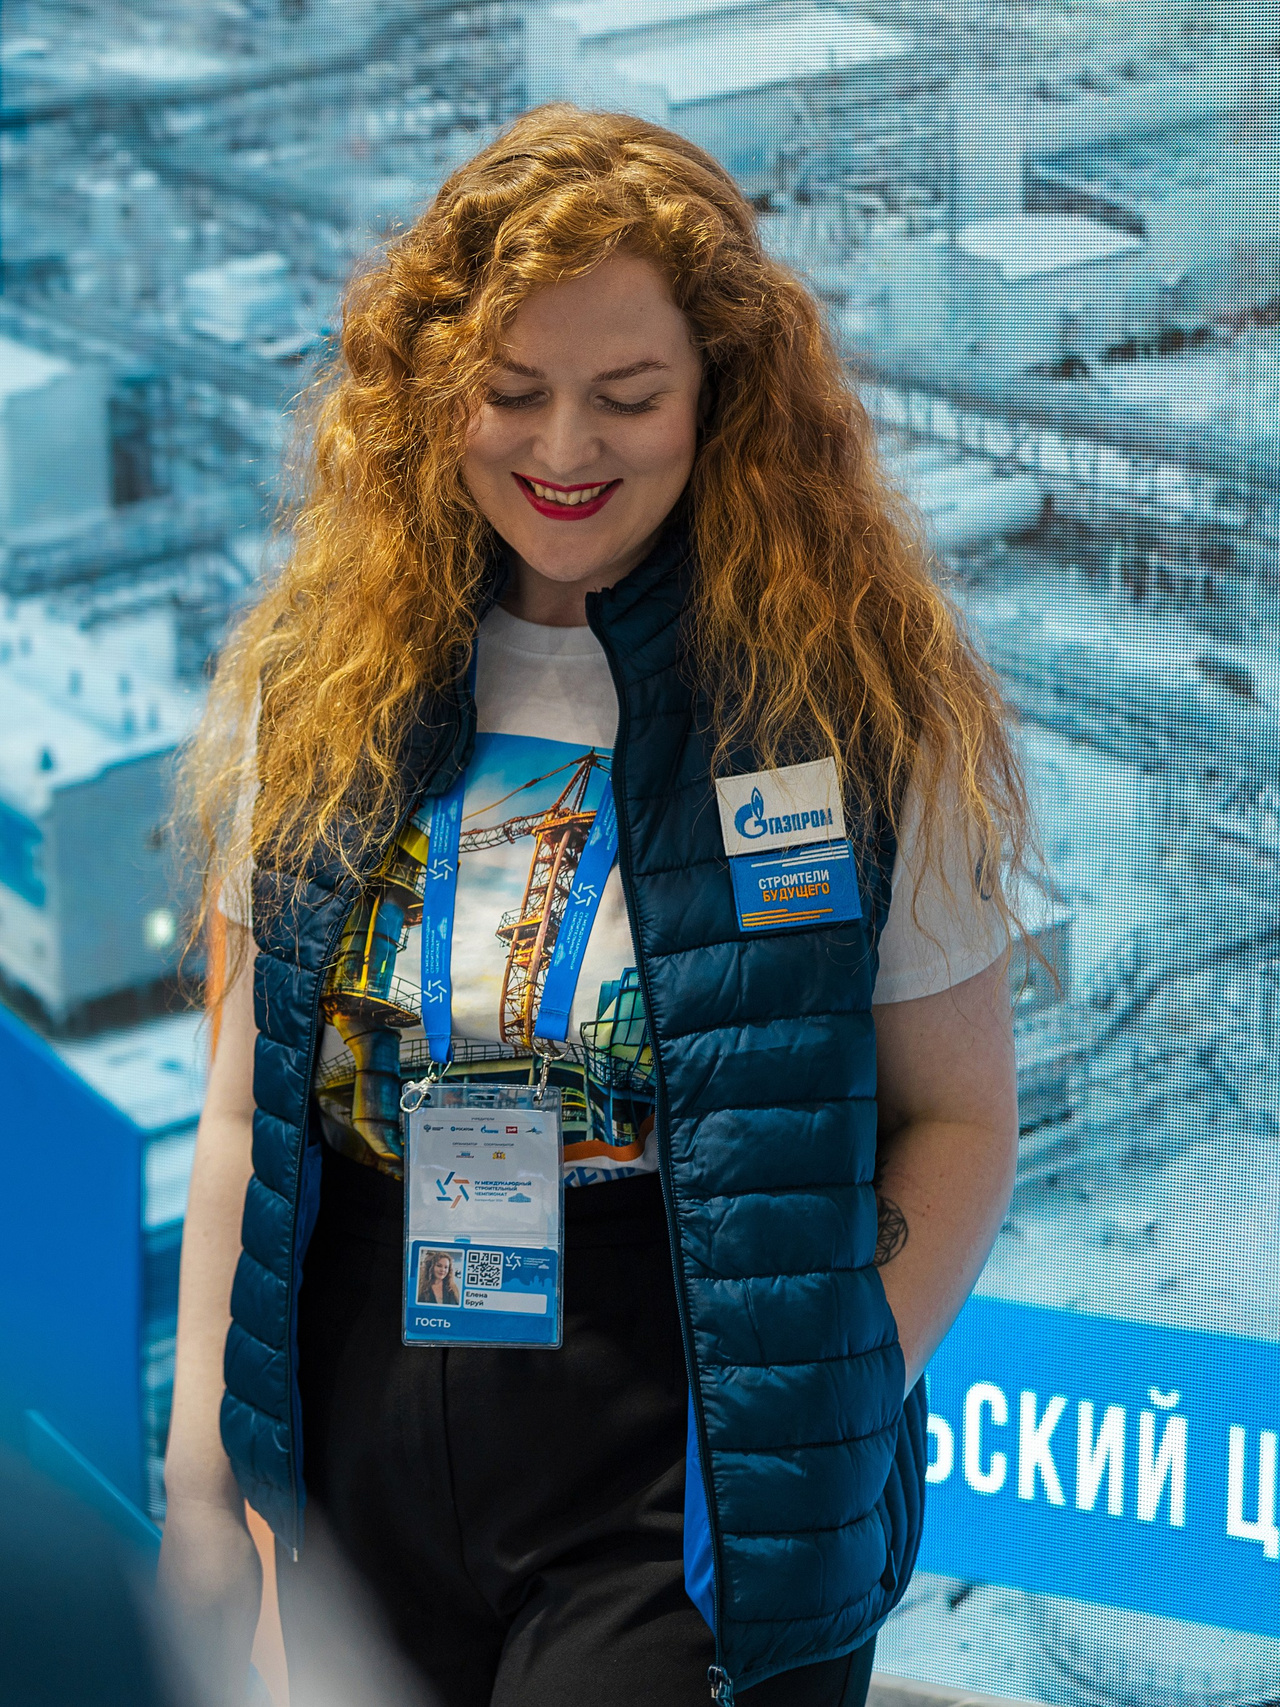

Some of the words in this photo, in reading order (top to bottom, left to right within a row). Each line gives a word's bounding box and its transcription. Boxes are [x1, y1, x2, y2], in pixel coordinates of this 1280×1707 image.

[767, 807, 833, 836] ГАЗПРОМ
[758, 869, 830, 891] СТРОИТЕЛИ
[762, 882, 831, 903] БУДУЩЕГО
[465, 1291, 488, 1299] Елена
[465, 1299, 484, 1307] Бруй
[415, 1317, 451, 1328] ГОСТЬ
[1225, 1423, 1280, 1562] Ц
